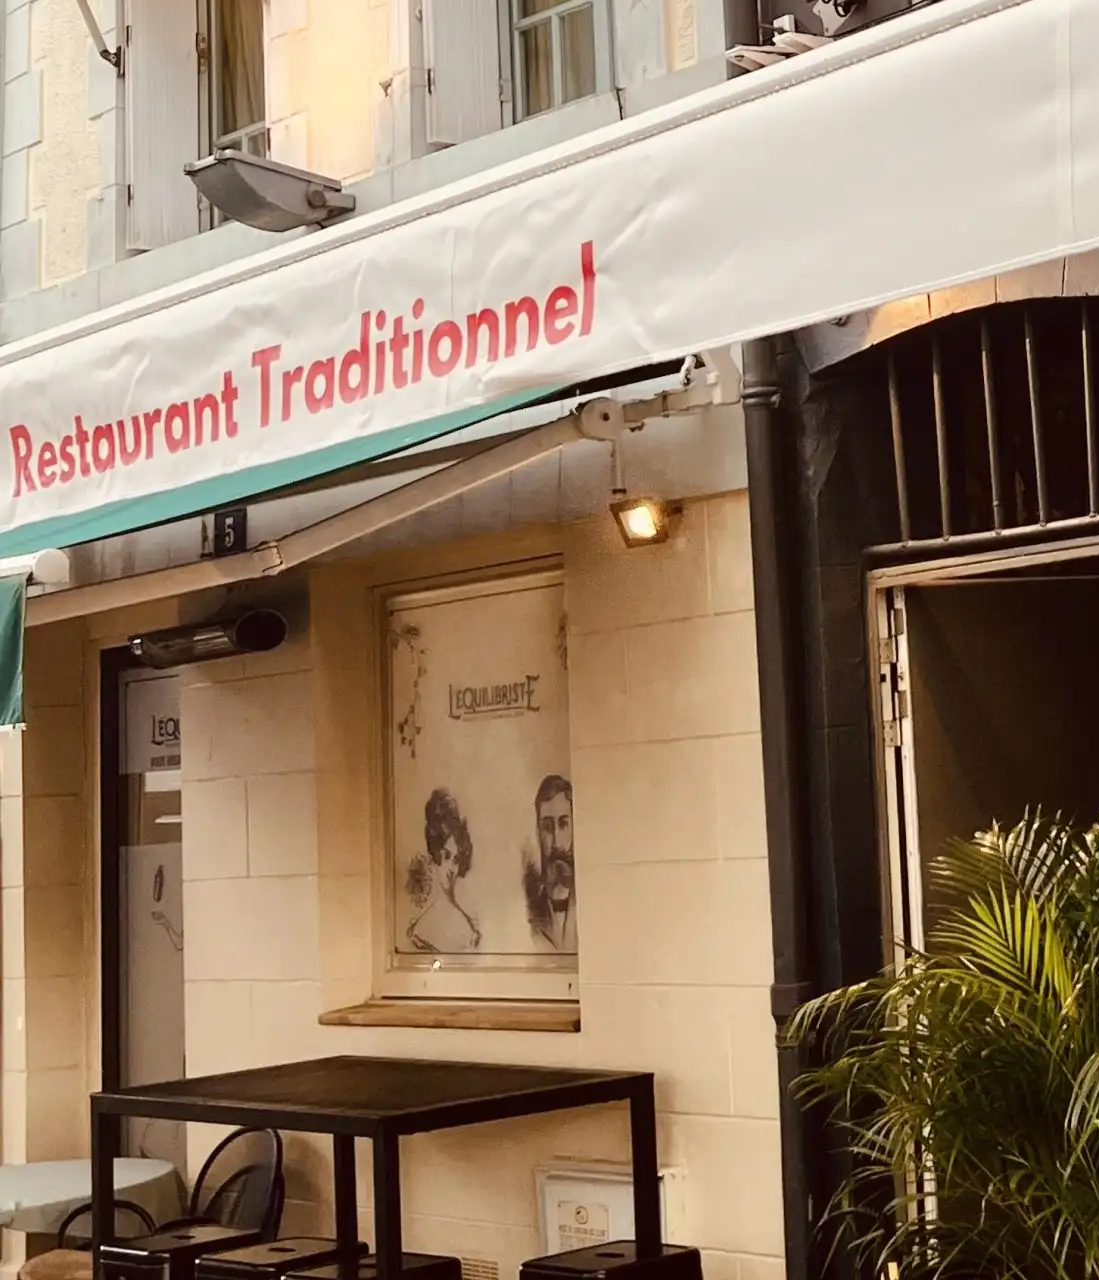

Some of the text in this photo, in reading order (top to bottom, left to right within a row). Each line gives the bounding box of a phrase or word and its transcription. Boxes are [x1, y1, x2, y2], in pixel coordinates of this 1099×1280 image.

[9, 241, 597, 497] Restaurant Traditionnel
[224, 516, 235, 548] 5
